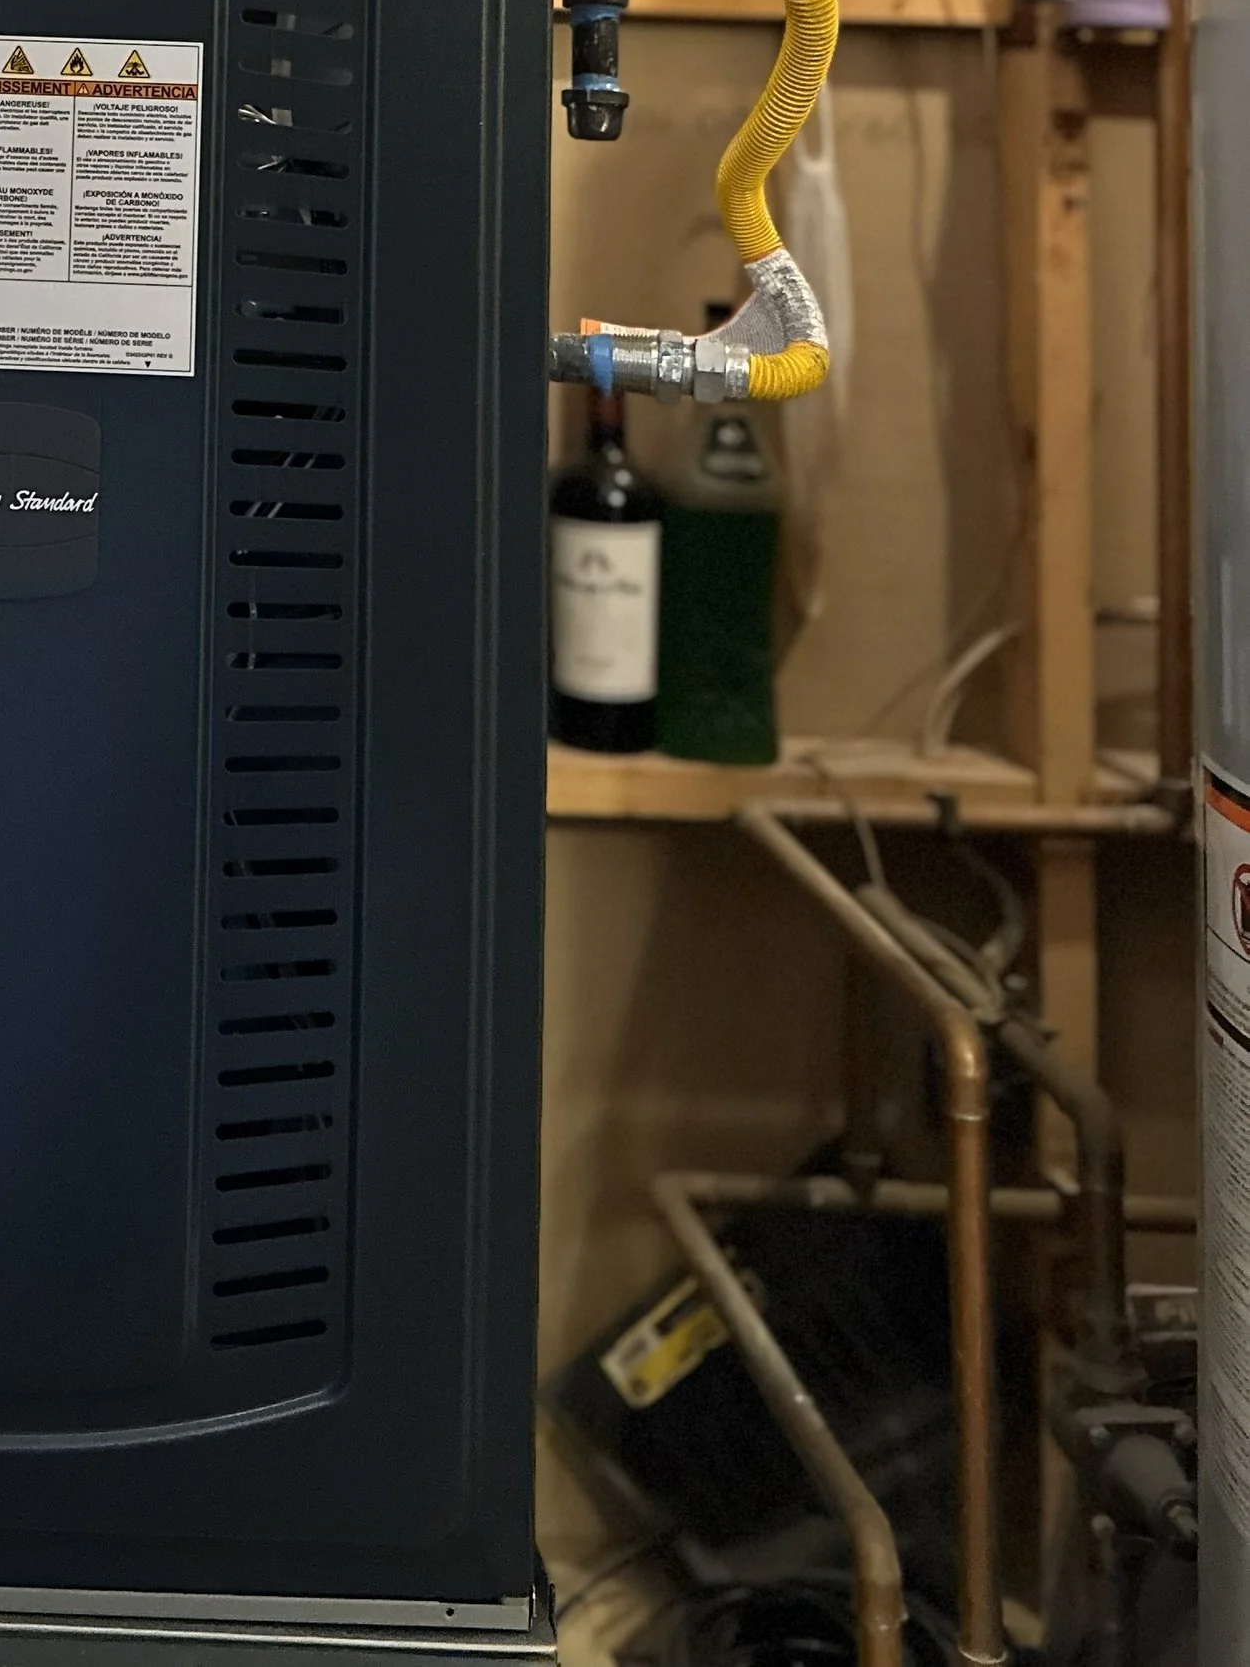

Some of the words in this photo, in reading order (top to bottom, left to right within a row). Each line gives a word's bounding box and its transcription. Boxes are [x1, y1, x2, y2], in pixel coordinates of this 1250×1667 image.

[91, 83, 196, 99] ADVERTENCIA
[93, 103, 129, 111] ¡VOLTAJE
[131, 104, 178, 112] PELIGROSO!
[86, 149, 124, 157] ¡VAPORES
[126, 151, 182, 159] INFLAMABLES!
[9, 187, 53, 195] MONOXYDE
[83, 189, 132, 199] ¡EXPOSICIÓN
[141, 191, 183, 200] MONÓXIDO
[102, 233, 161, 243] ¡ADVERTENCIA!
[20, 326, 51, 334] NUMÉRO
[63, 328, 92, 336] MODÈLE
[89, 337, 119, 345] NÚMERO
[9, 489, 98, 512] Standard
